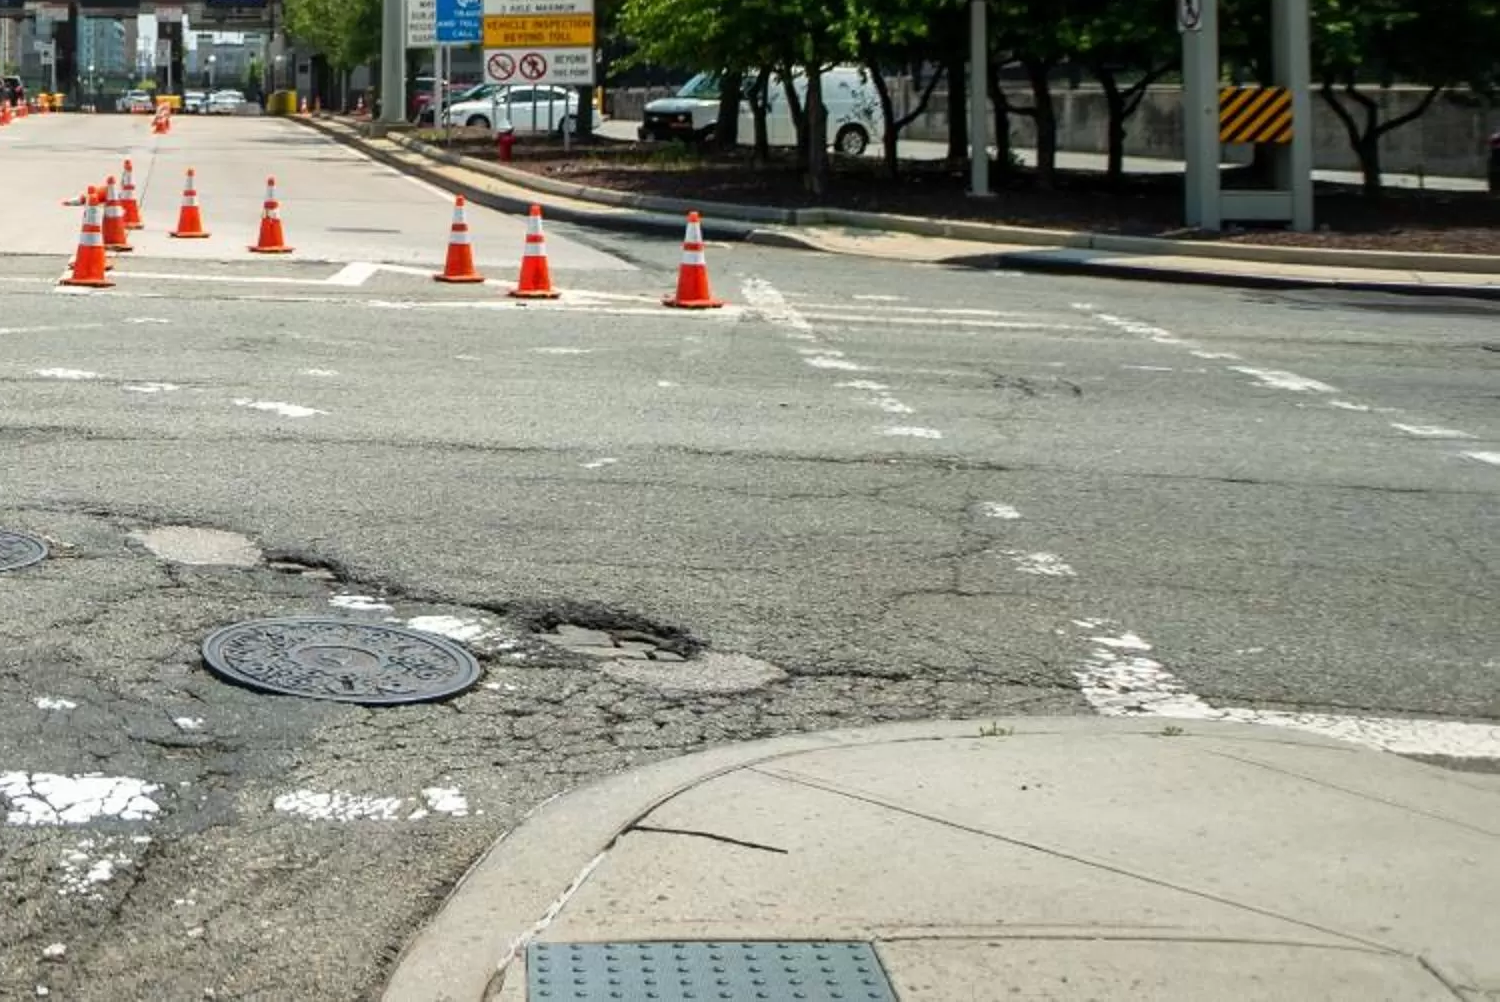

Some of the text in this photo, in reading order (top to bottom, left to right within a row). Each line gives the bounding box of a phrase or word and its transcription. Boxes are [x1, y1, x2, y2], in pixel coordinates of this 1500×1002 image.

[535, 3, 576, 11] MAXIMUM
[487, 19, 590, 30] VEHICLE INSPECTION
[504, 32, 573, 42] BEYOND TOLL
[555, 54, 587, 64] BEYOND
